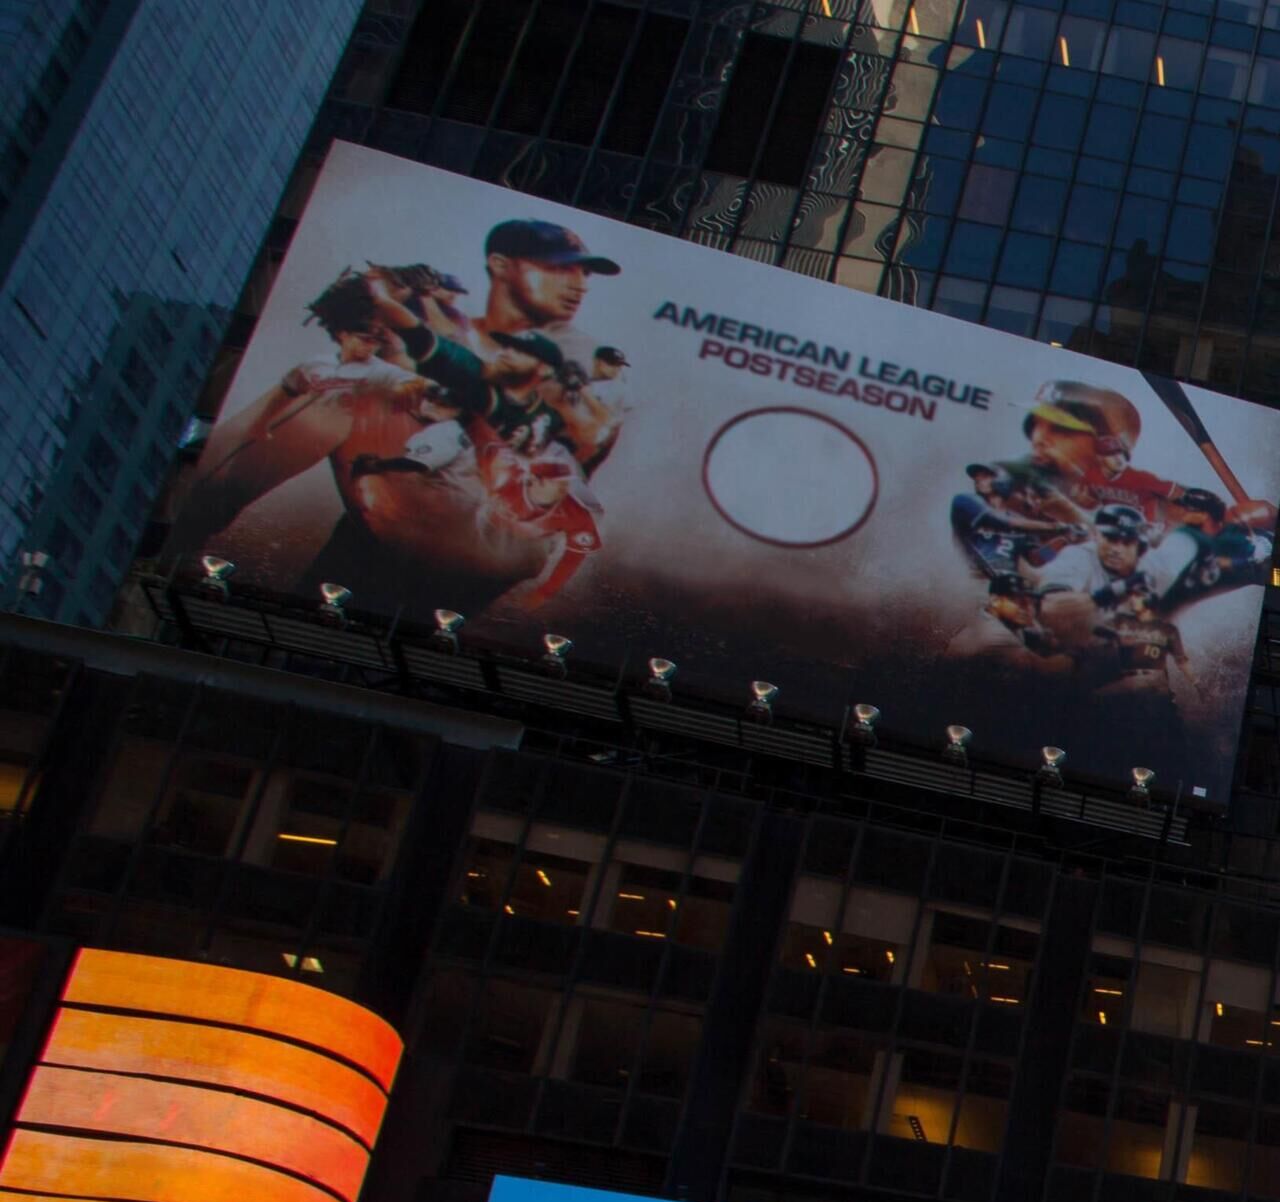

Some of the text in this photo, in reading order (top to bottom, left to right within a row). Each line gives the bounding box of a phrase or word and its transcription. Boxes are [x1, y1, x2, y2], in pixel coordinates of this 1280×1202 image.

[653, 301, 994, 411] AMERICAN LEAGUE
[698, 339, 938, 422] POSTSEASON
